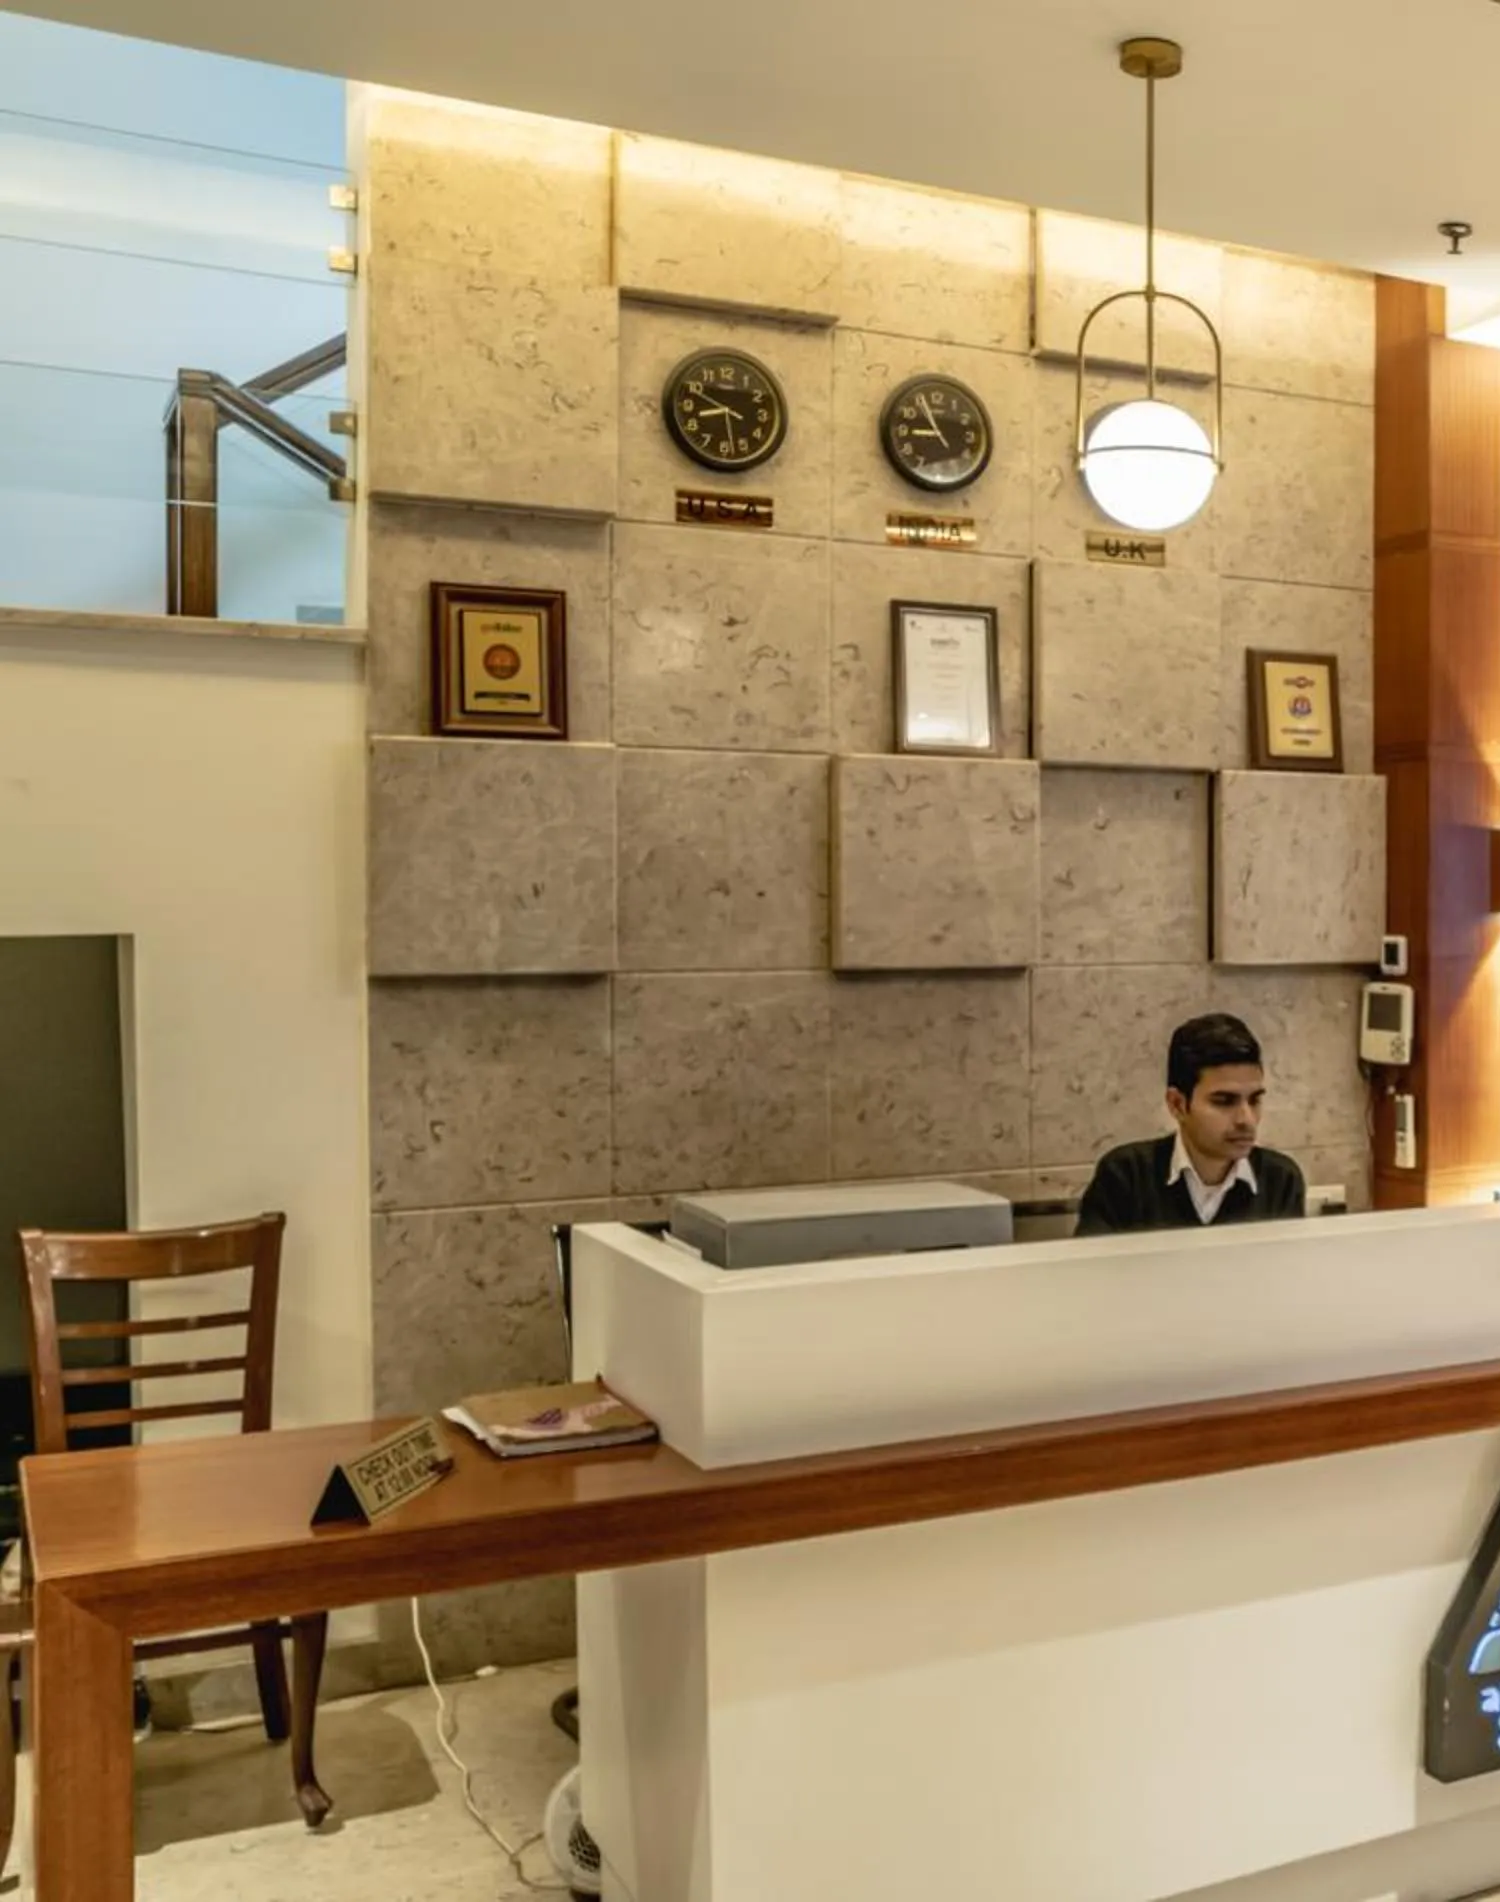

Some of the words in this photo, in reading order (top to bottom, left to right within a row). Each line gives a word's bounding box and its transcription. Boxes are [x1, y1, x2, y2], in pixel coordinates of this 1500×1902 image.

[357, 1453, 396, 1486] CHECK
[391, 1440, 414, 1466] OUT
[410, 1430, 437, 1455] TIME
[374, 1480, 389, 1502] AT
